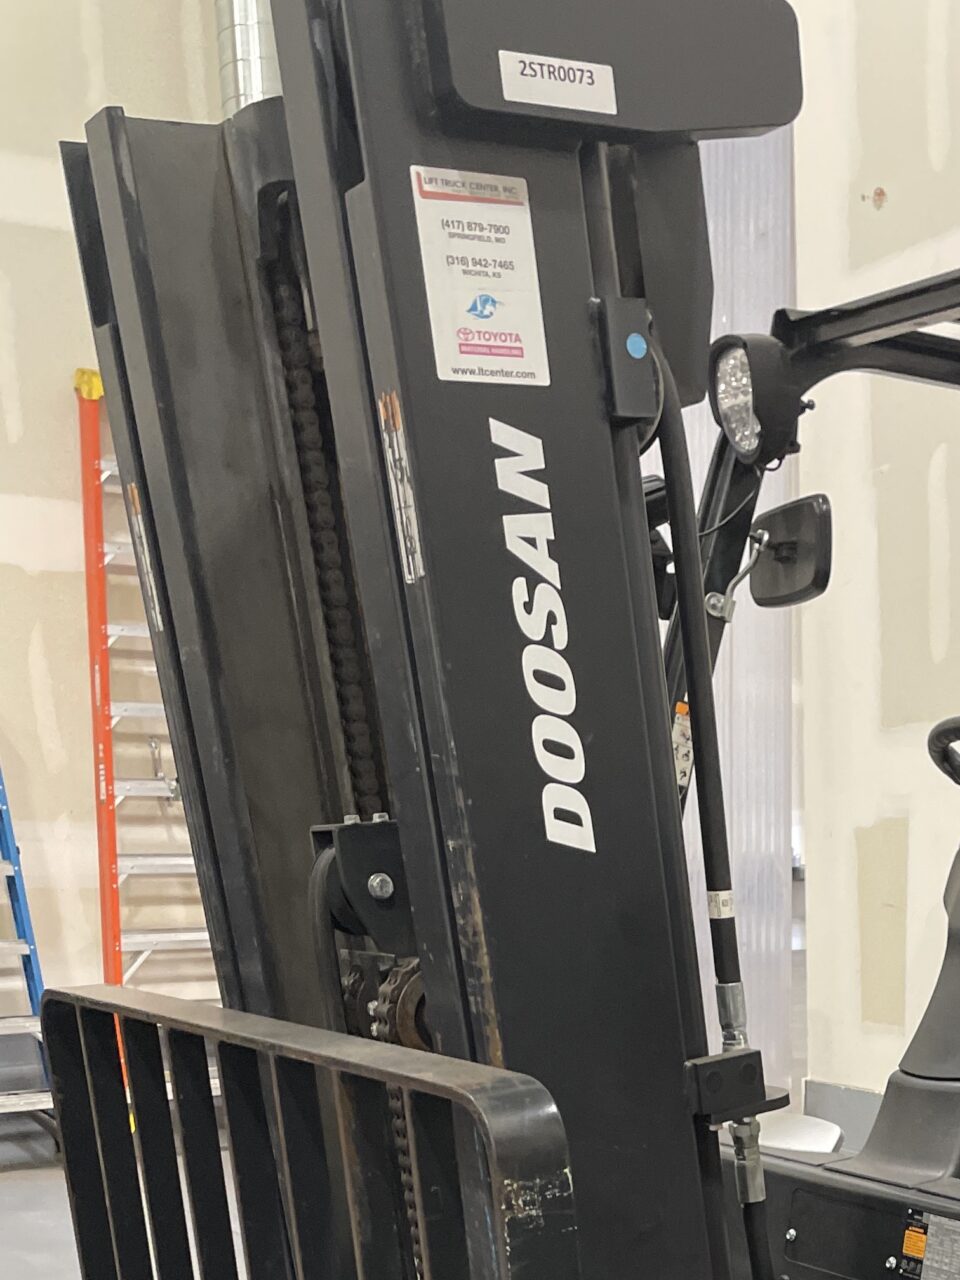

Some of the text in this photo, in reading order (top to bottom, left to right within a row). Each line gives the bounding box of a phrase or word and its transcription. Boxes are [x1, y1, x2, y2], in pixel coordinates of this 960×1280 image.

[518, 60, 595, 86] 2STR0073
[441, 218, 510, 235] (417) 879-7900
[446, 255, 515, 271] (316) 942-7465
[475, 330, 522, 343] TOYOTA
[488, 416, 597, 854] DOOSAN
